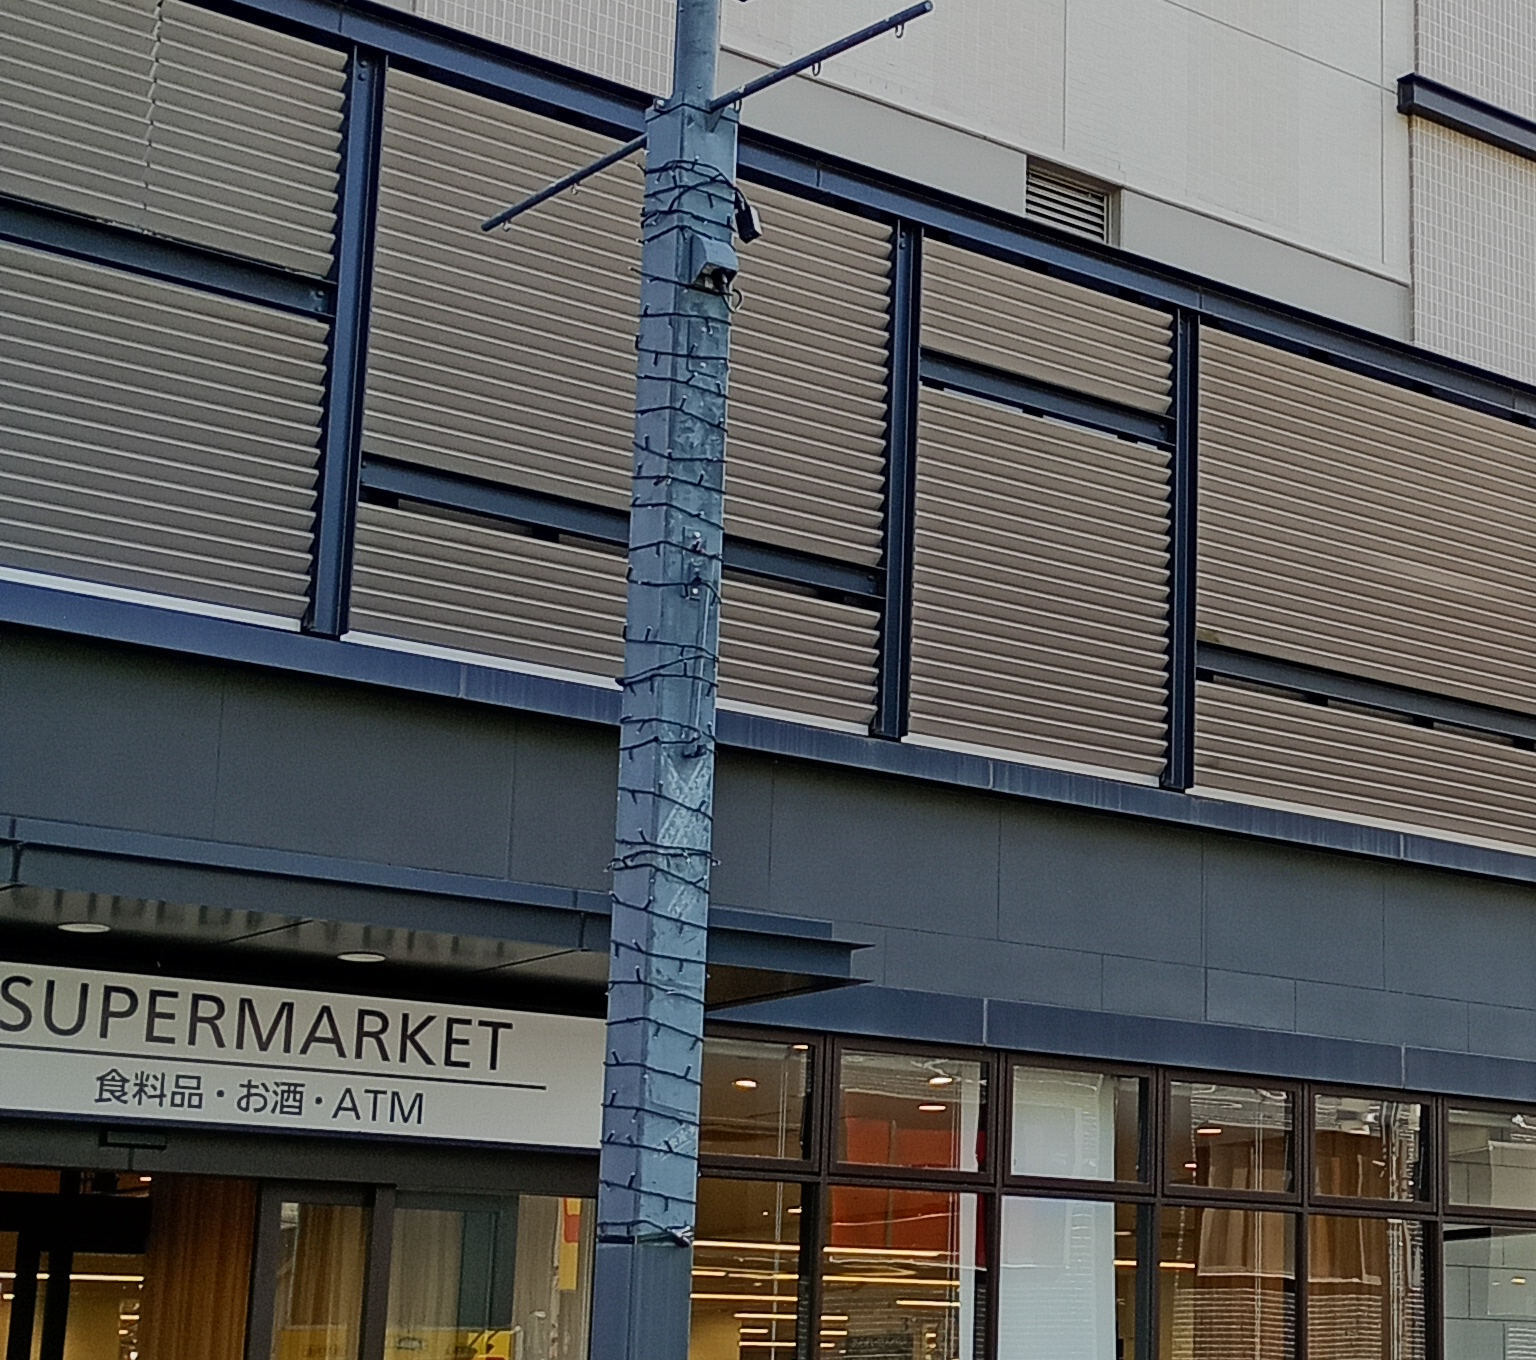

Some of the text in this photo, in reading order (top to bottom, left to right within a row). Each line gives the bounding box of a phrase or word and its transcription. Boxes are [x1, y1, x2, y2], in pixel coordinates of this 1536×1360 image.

[0, 974, 514, 1072] SUPERMARKET
[93, 1067, 425, 1127] 食料品・お酒・ATM
